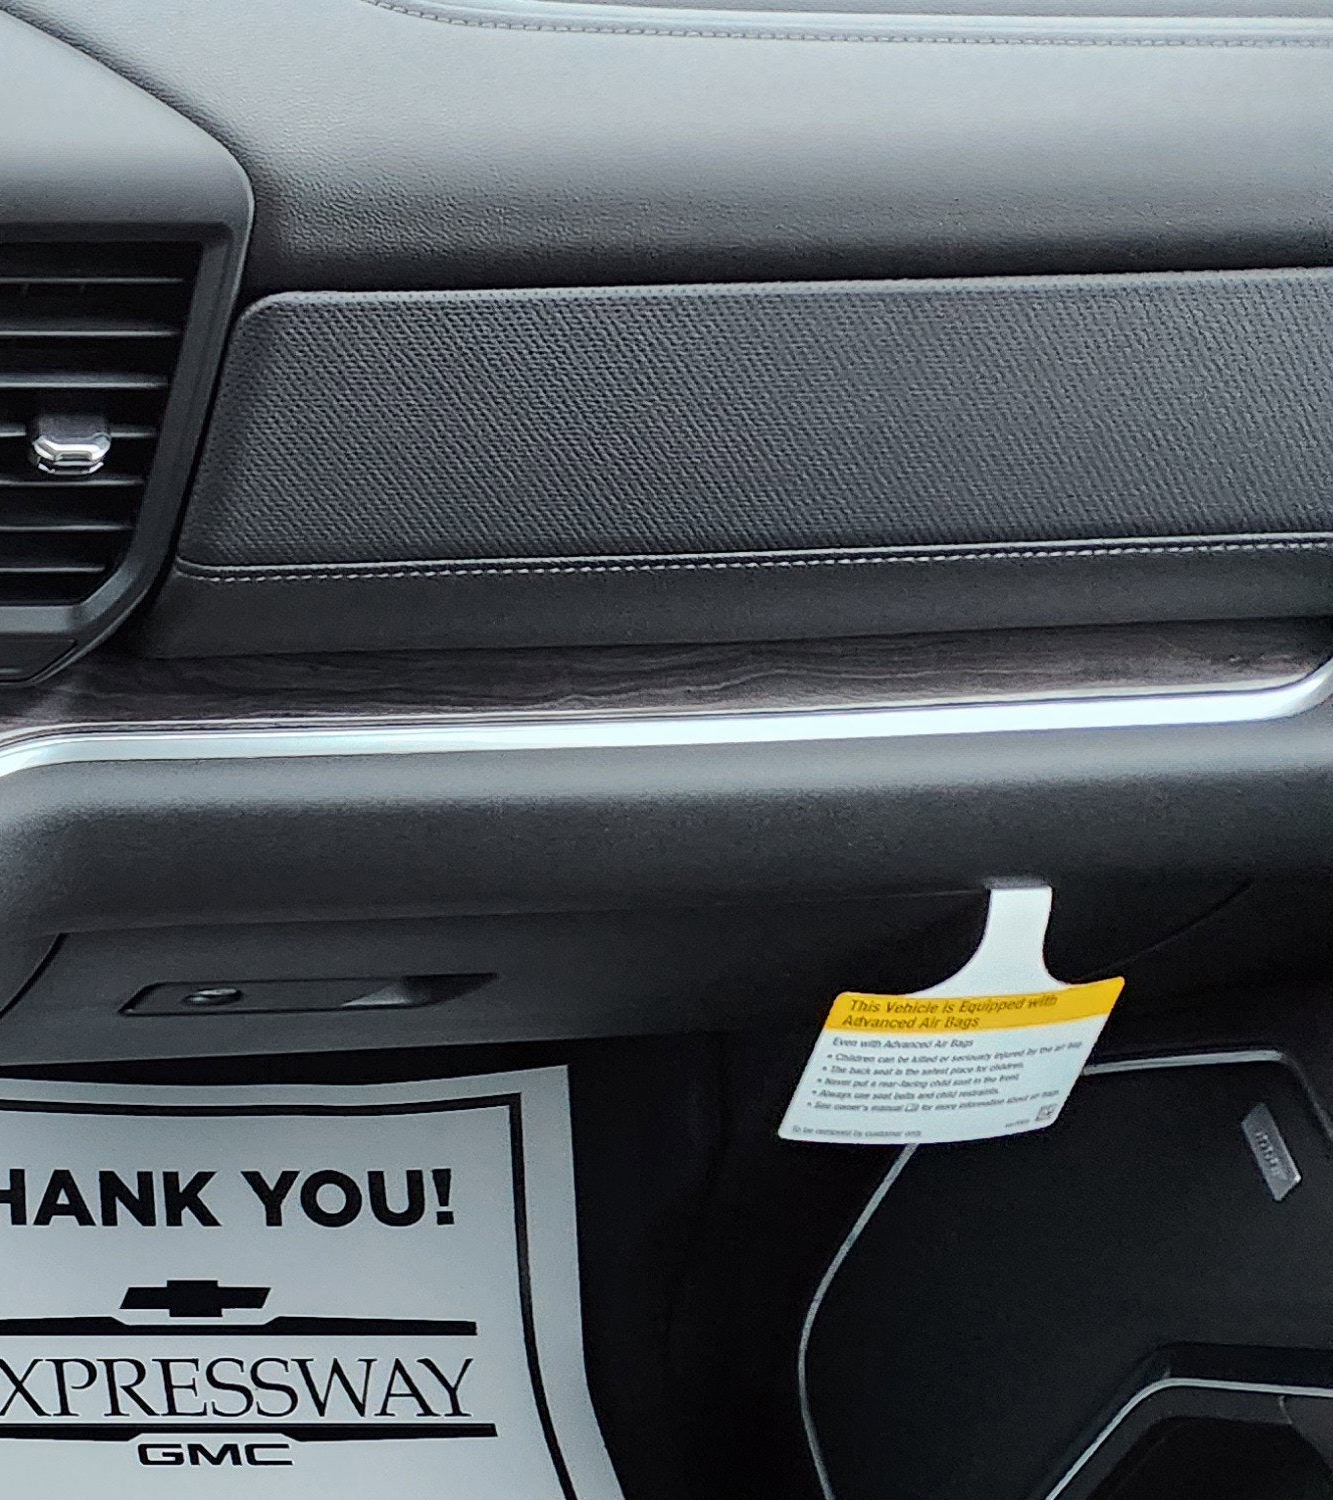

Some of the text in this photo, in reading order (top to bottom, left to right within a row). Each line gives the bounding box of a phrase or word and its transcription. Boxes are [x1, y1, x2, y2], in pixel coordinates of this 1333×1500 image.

[851, 1000, 881, 1012] This
[886, 1001, 939, 1014] Vehicle
[959, 1001, 1025, 1014] Equipped
[1028, 995, 1058, 1007] with
[842, 1015, 980, 1030] Advanced Air Bags
[832, 1037, 974, 1048] Even with Advanced Air Bags
[835, 1053, 875, 1063] Children
[951, 1052, 991, 1063] seriously
[994, 1050, 1025, 1060] injured
[849, 1066, 871, 1075] back
[240, 1167, 457, 1228] YOU!
[136, 1441, 295, 1468] GMC
